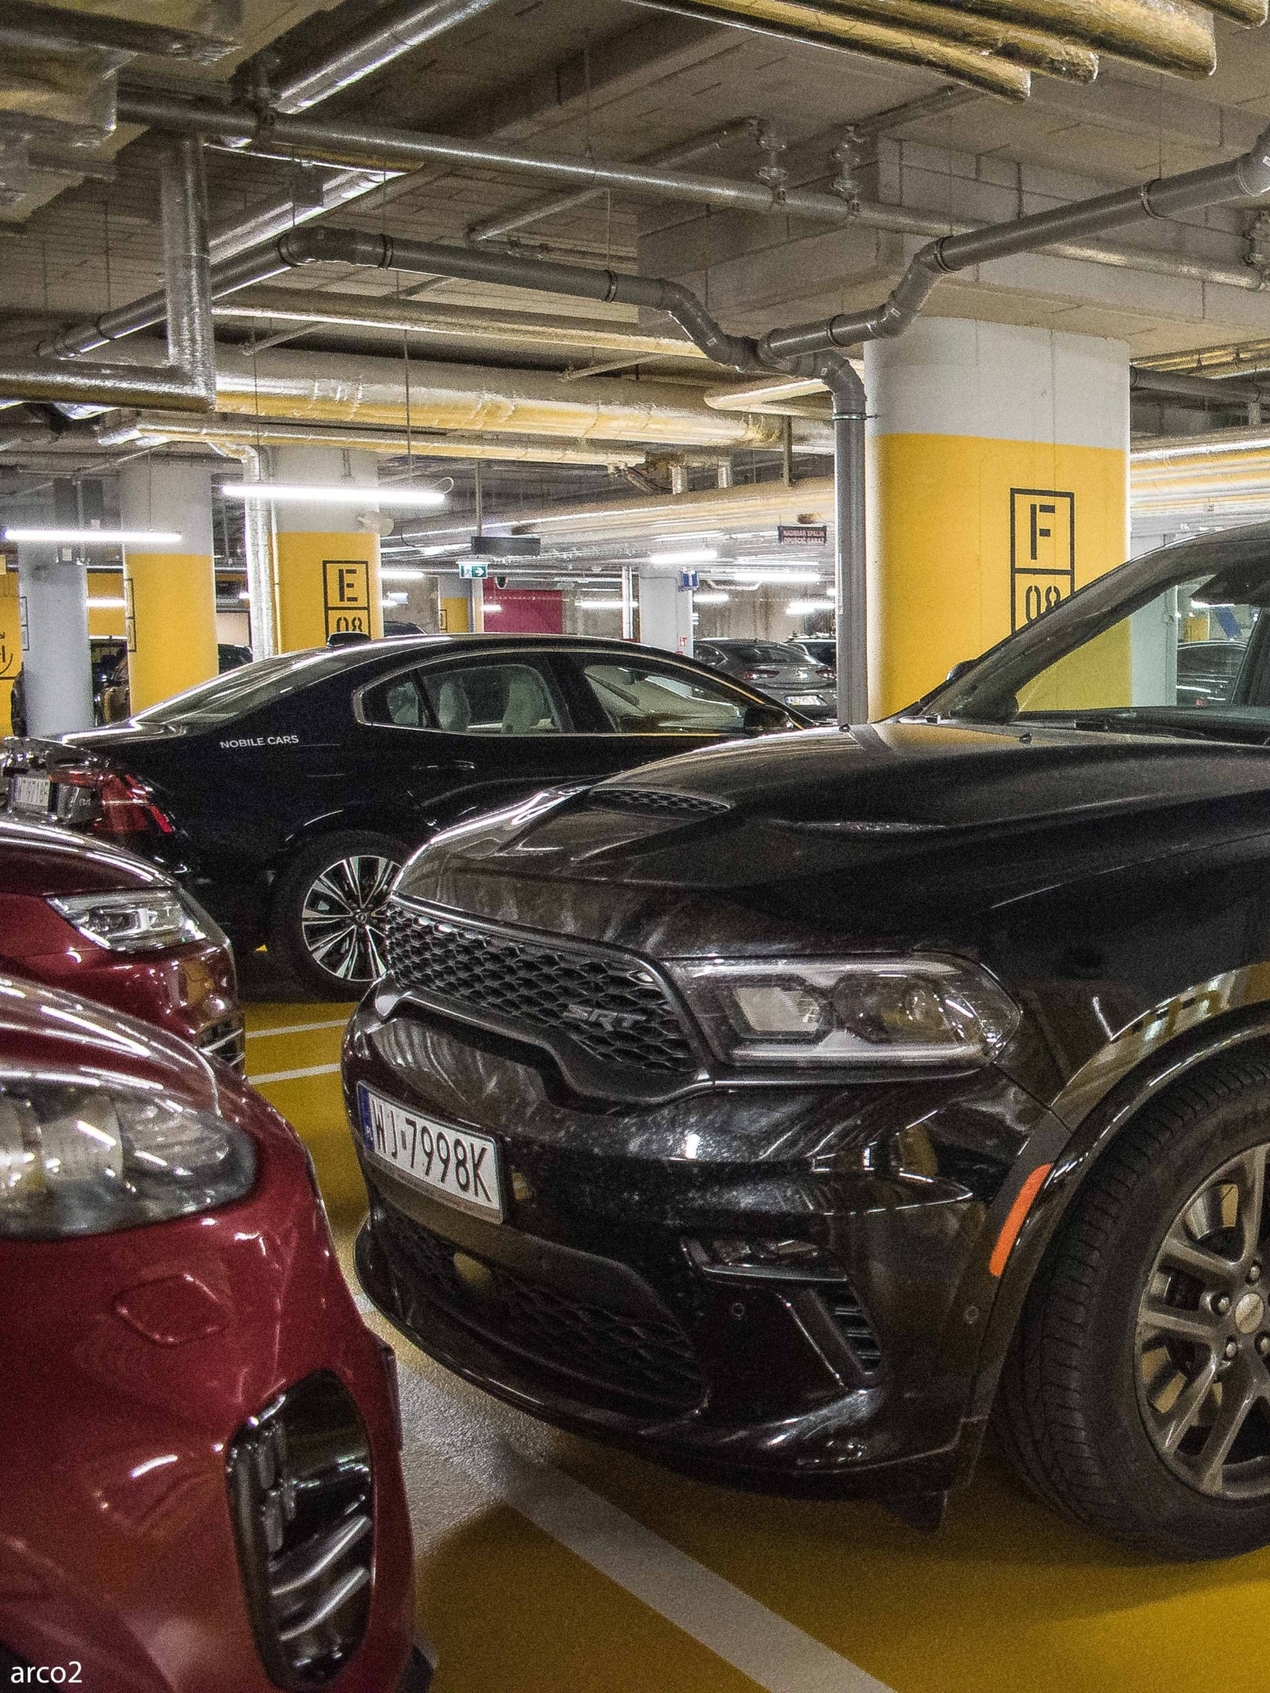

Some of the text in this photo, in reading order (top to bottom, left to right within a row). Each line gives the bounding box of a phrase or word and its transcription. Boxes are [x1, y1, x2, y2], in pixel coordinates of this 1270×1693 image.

[1030, 504, 1055, 561] F
[338, 569, 358, 602] E
[220, 735, 299, 748] NOBILE CARS
[562, 1004, 647, 1031] SRT
